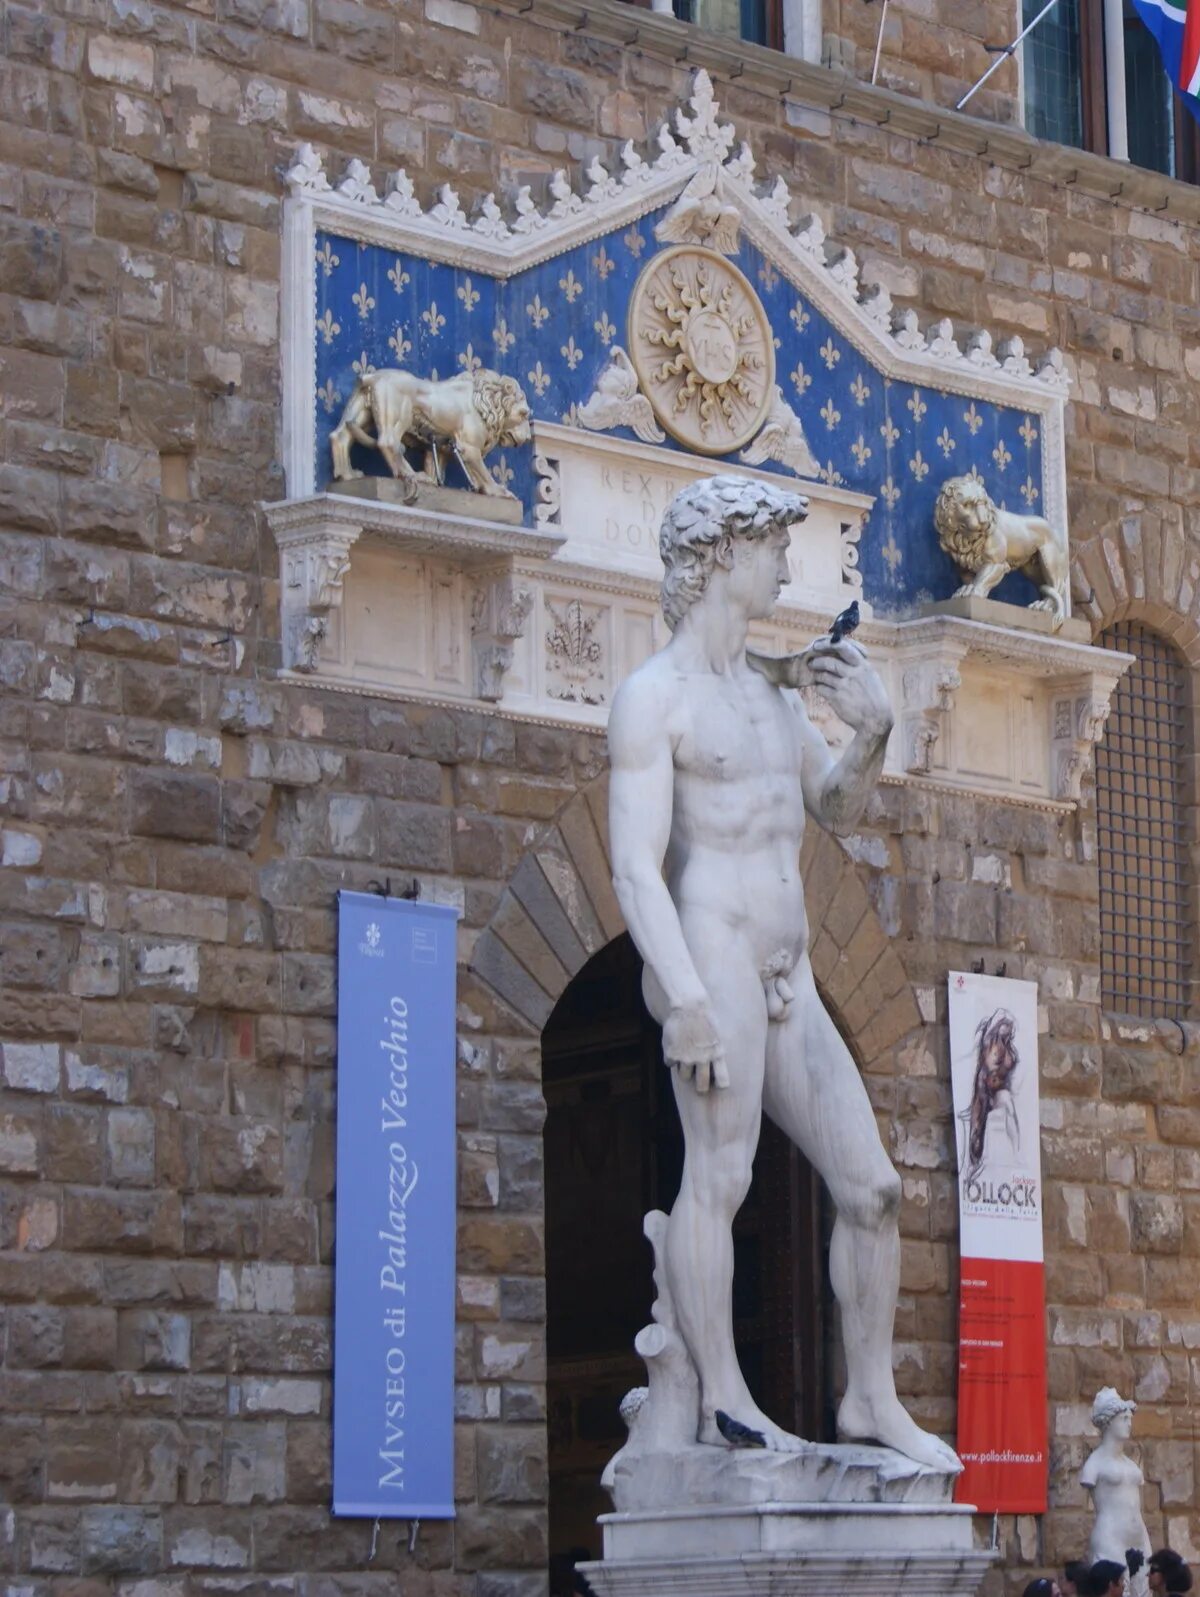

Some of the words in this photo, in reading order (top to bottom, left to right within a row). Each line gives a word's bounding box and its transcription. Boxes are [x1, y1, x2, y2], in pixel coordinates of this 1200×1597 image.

[601, 464, 652, 499] REX
[379, 996, 409, 1132] Vecchio
[378, 1142, 419, 1297] Palazzo
[383, 1307, 406, 1339] di
[378, 1347, 406, 1491] MVSEO
[960, 1450, 1042, 1464] www.pollockfirenze.it
